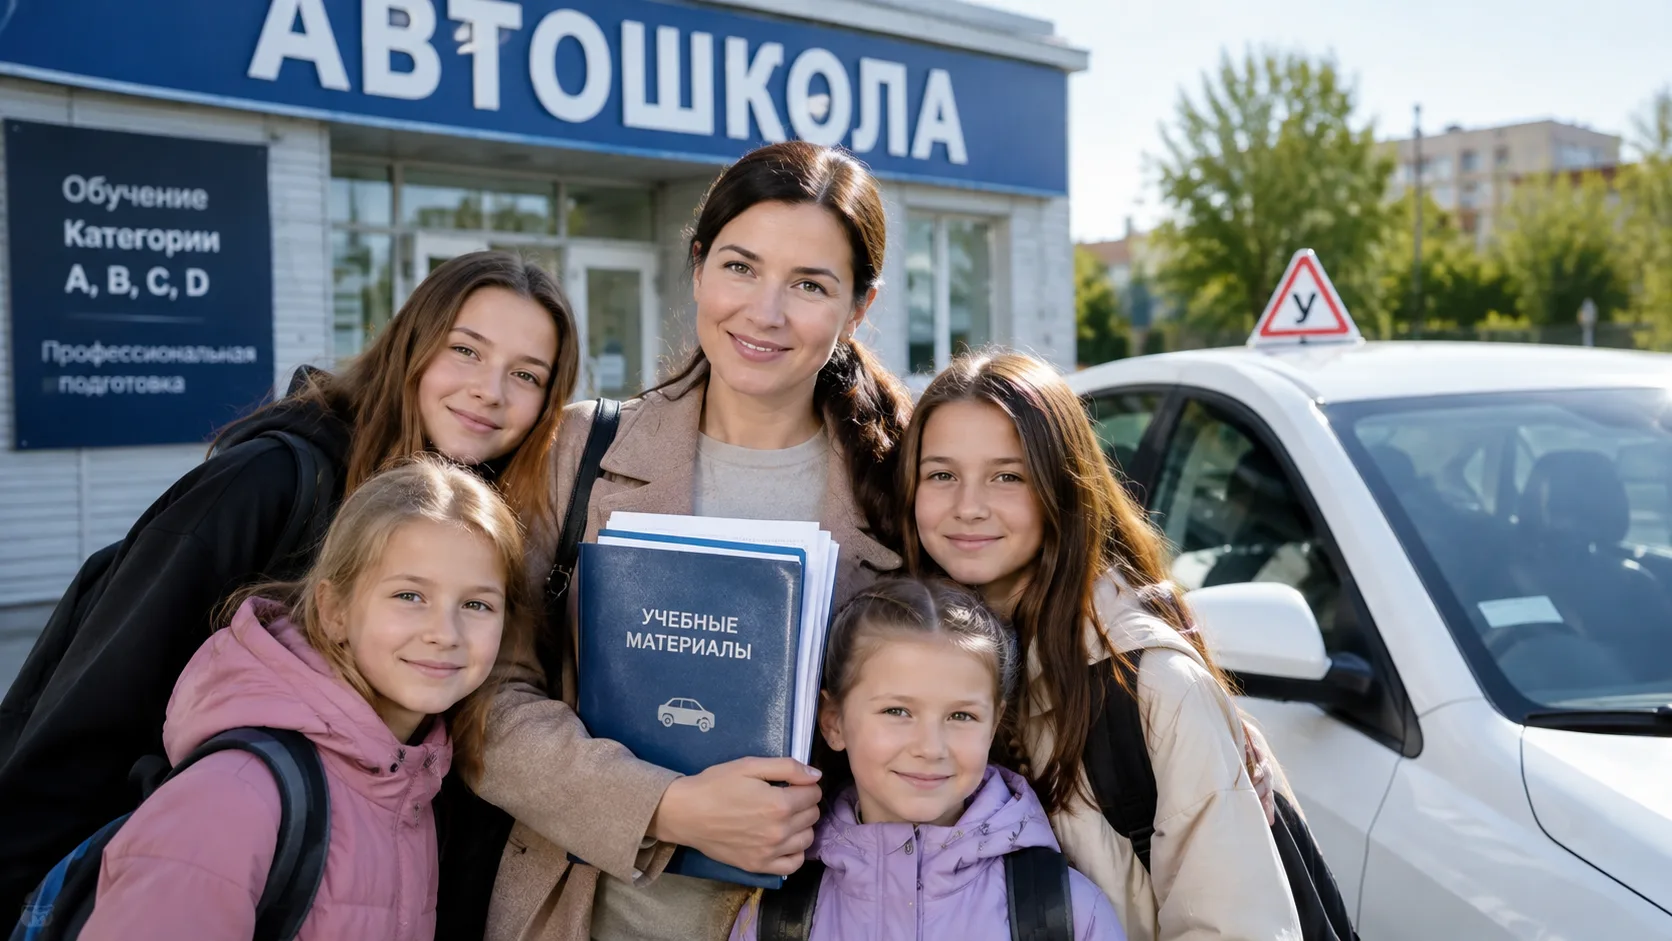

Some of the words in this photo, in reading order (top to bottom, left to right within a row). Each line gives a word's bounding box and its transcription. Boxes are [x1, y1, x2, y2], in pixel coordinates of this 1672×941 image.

[247, 0, 968, 165] АВТОШКОЛА
[62, 174, 208, 211] Обучение
[63, 218, 220, 257] Категории
[64, 263, 98, 298] A,
[107, 264, 140, 299] B,
[146, 266, 178, 300] C,
[186, 268, 209, 296] D
[1293, 293, 1316, 324] У
[41, 340, 257, 367] Профессиональная
[58, 375, 186, 397] подготовка
[642, 608, 738, 634] УЧЕБНЫЕ
[626, 631, 752, 660] МАТЕРИАЛЫ
